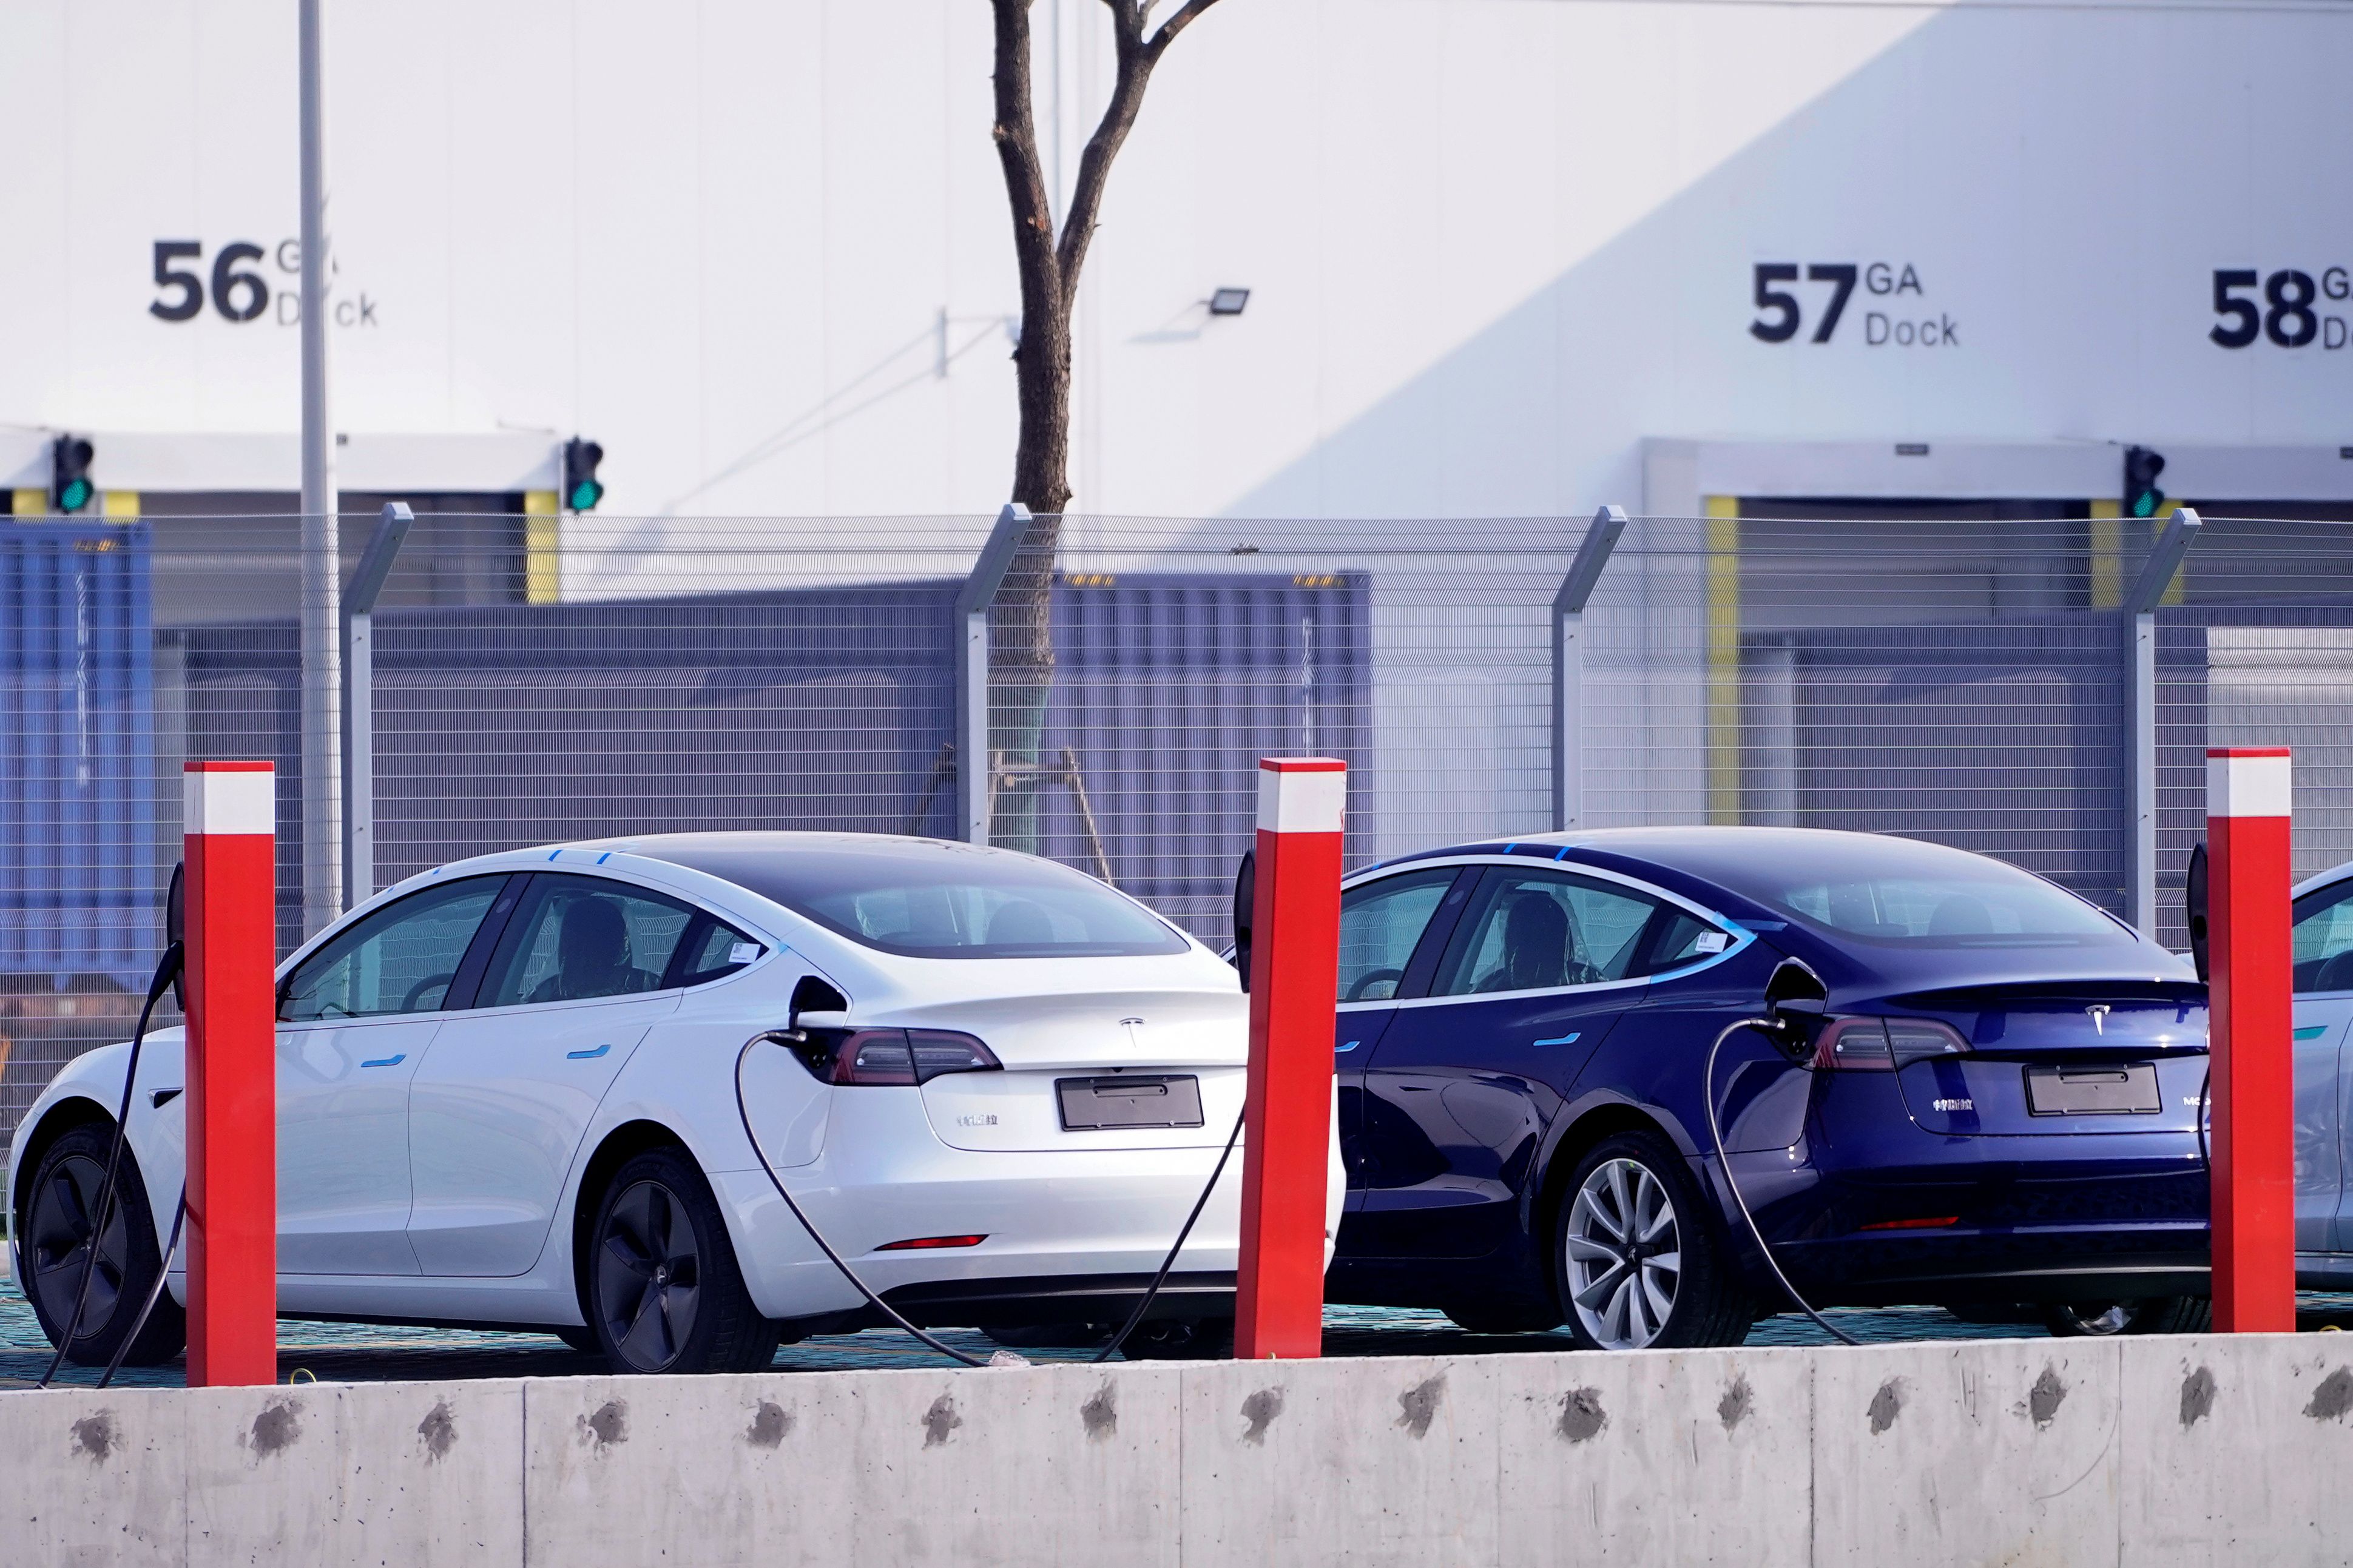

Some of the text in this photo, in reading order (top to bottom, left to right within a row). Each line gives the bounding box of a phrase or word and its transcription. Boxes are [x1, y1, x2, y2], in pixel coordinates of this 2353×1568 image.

[277, 239, 339, 274] G
[149, 240, 269, 323] 56
[1865, 262, 1923, 295] GA
[2322, 267, 2353, 300] G
[277, 292, 377, 326] Dck
[1748, 262, 1857, 343] 57
[2208, 269, 2317, 349] 58
[1866, 312, 1958, 346] Dock
